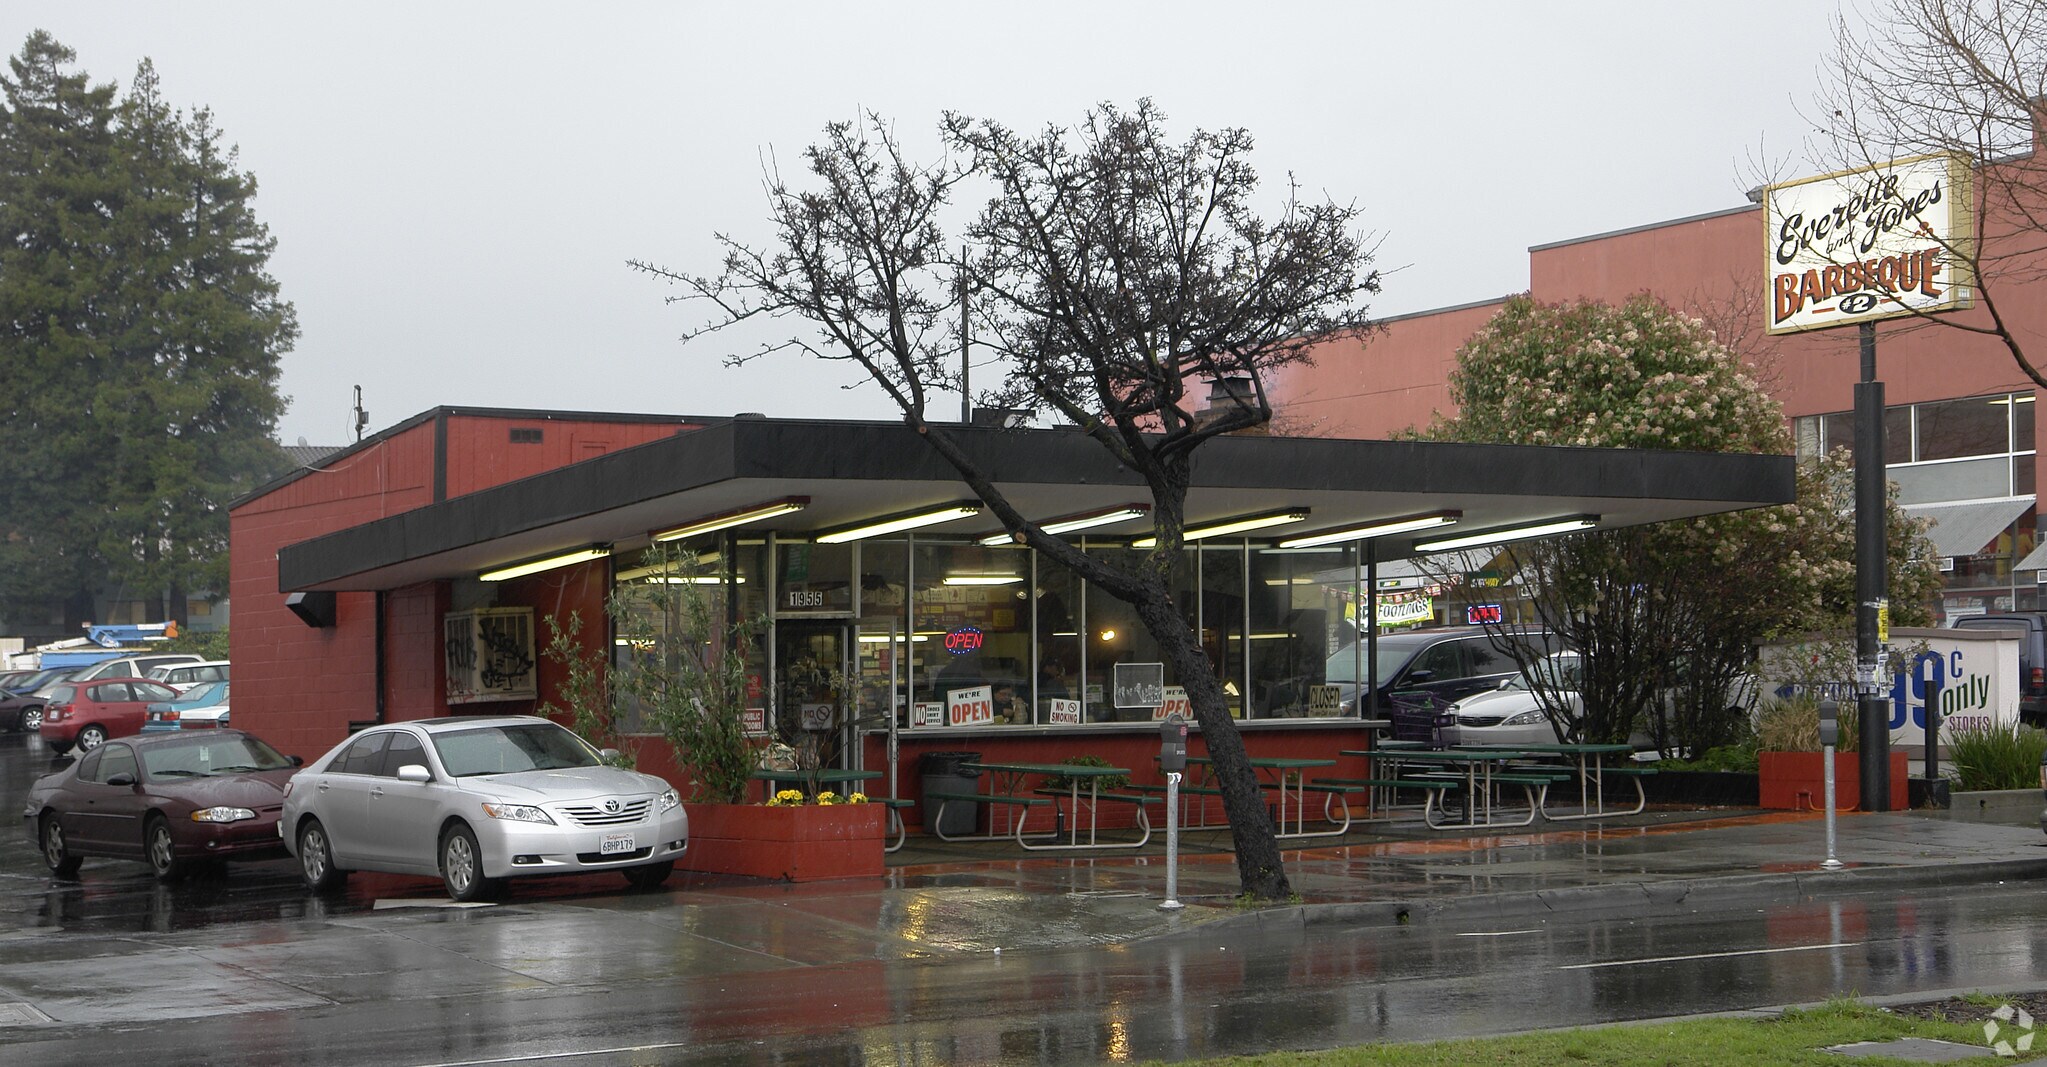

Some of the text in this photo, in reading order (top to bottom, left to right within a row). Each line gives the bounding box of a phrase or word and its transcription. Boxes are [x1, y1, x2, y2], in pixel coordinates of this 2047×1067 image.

[1776, 174, 1898, 265] Everette
[1860, 179, 1942, 254] Jones
[1826, 226, 1856, 254] and
[1774, 247, 1944, 325] BARBEQUE
[1842, 296, 1870, 313] #2
[792, 592, 822, 605] 1955
[944, 632, 984, 649] OPEN
[958, 691, 981, 700] WE'RE
[1310, 687, 1340, 709] CLOSED
[1943, 674, 1990, 717] only
[804, 709, 815, 719] NO
[914, 705, 926, 725] NO
[952, 701, 991, 724] OPEN
[1056, 701, 1064, 711] NO
[1155, 699, 1192, 718] OPEN
[1051, 712, 1078, 723] SMOKING
[1949, 716, 1989, 732] STORES
[602, 839, 634, 852] 6BHP179
